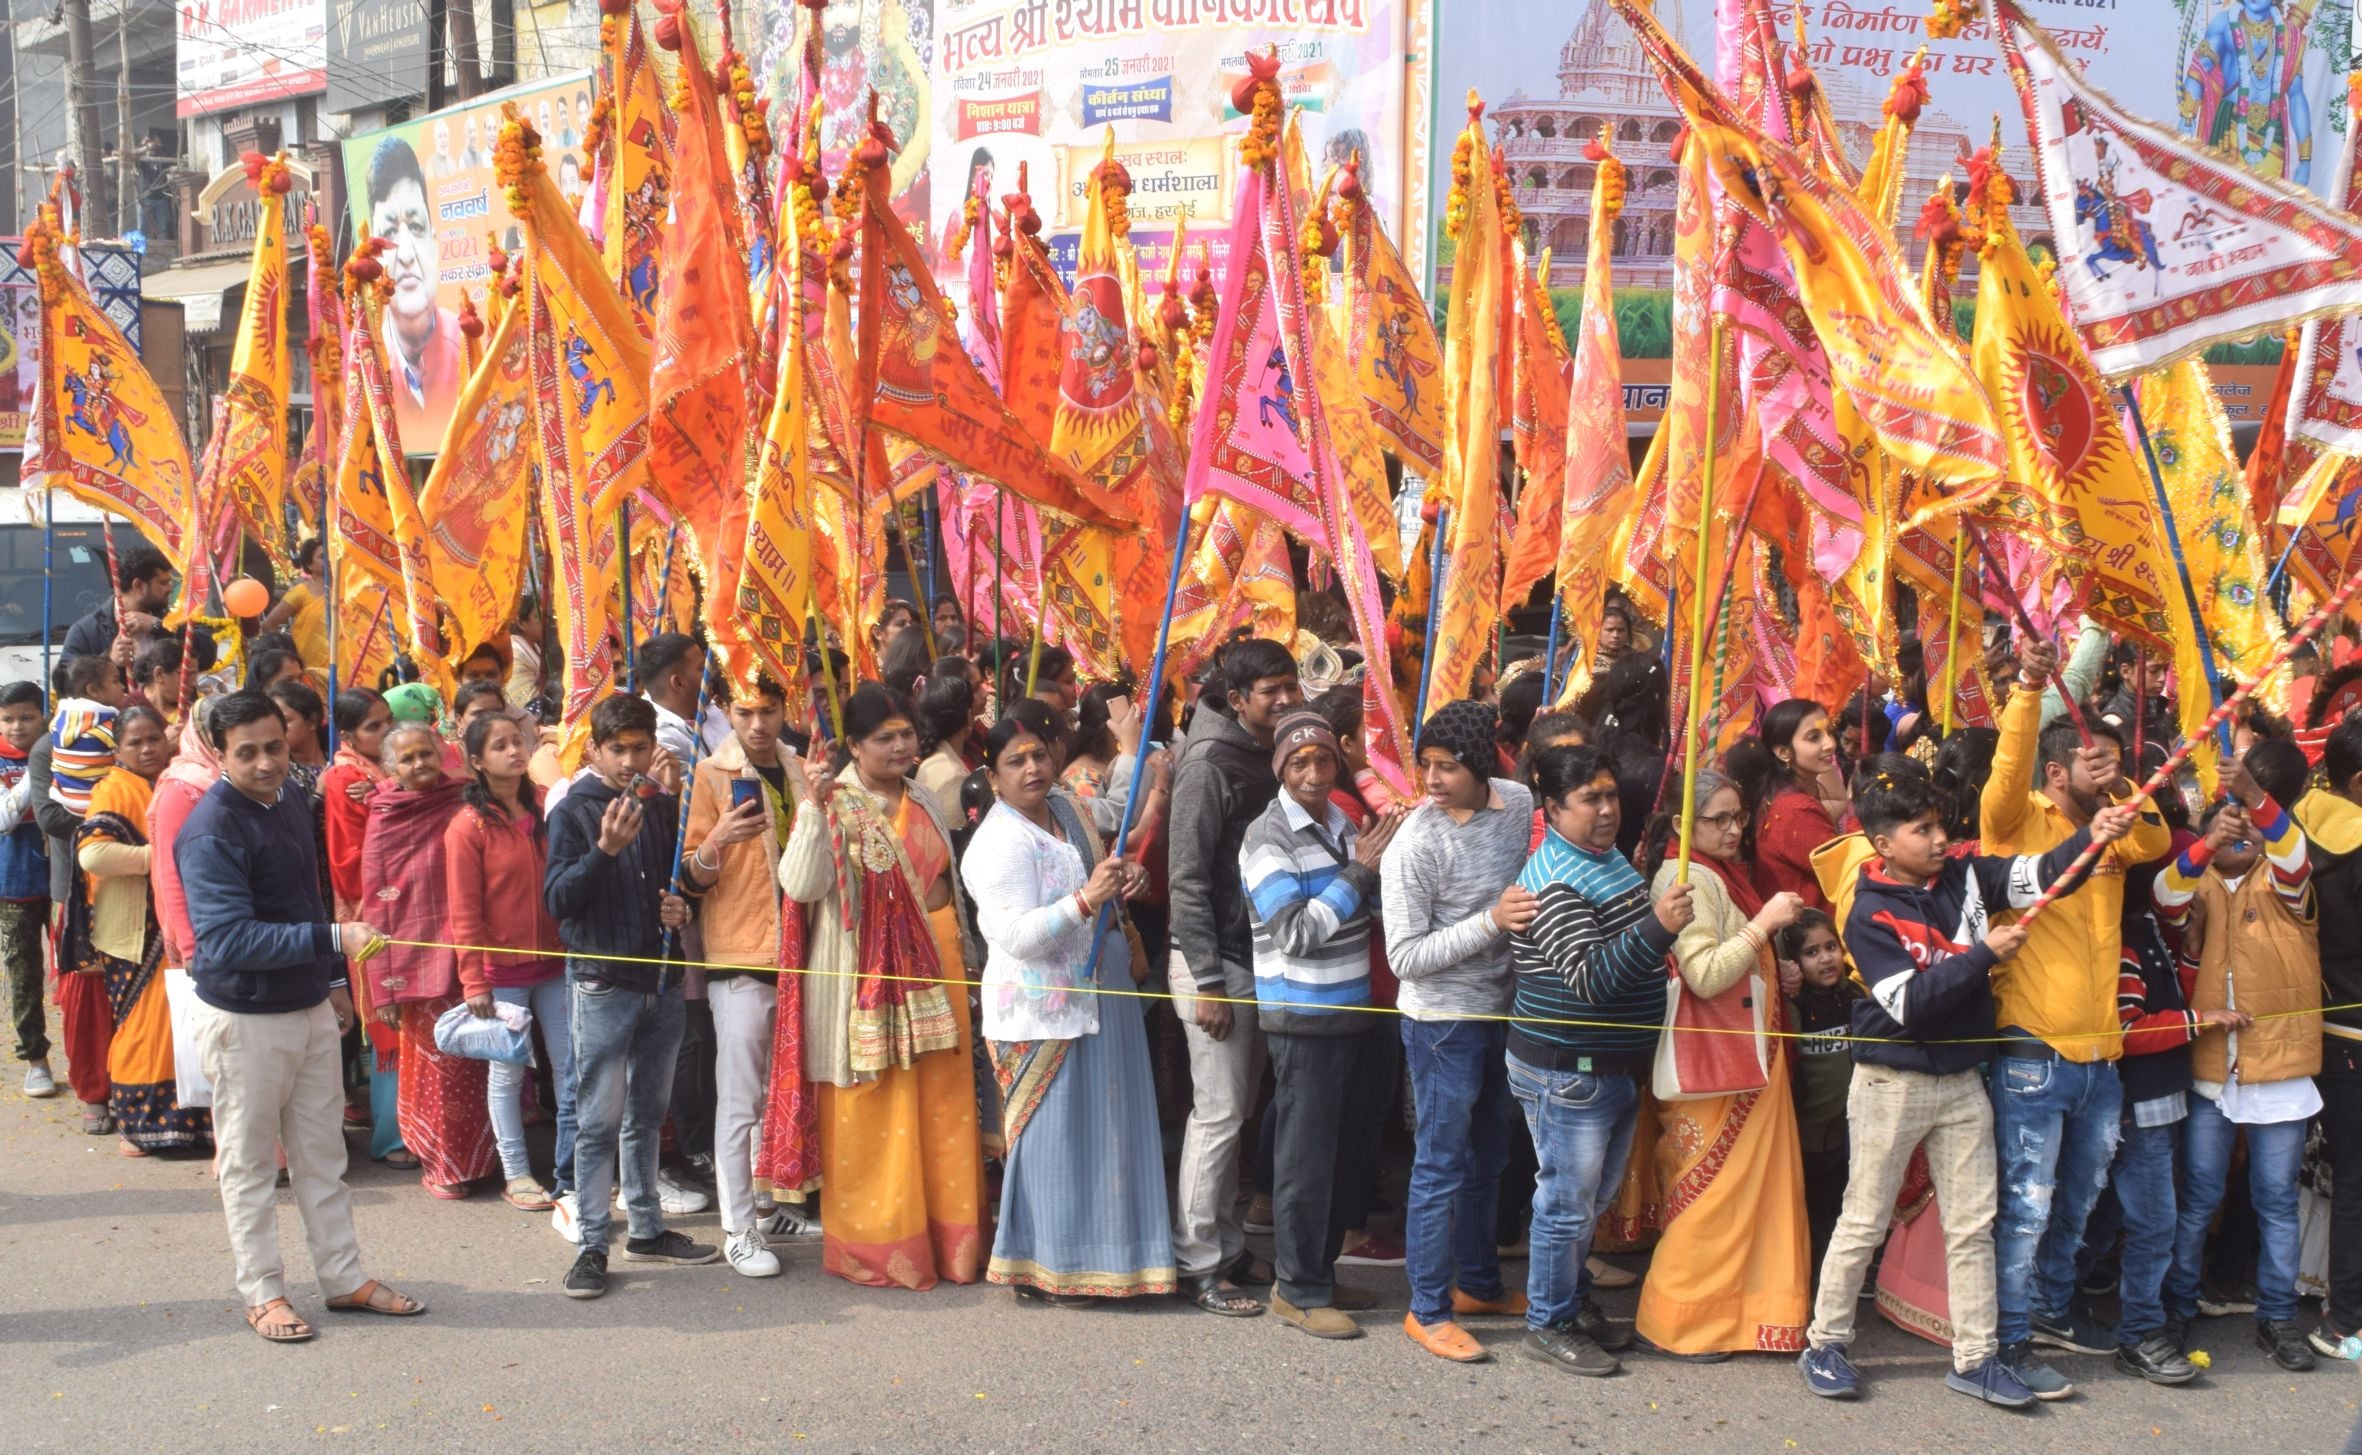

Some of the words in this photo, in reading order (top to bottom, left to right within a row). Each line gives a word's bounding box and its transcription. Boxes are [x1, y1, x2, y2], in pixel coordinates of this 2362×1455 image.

[1821, 0, 1922, 34] निर्माण
[1105, 57, 1119, 77] 25
[1121, 52, 1150, 74] जनवरी
[1152, 55, 1175, 72] 2021
[1840, 46, 1895, 77] प्रभु
[1952, 54, 1996, 76] घर
[978, 71, 991, 90] 24
[993, 66, 1021, 88] जनवरी
[1022, 69, 1044, 86] 2021
[966, 102, 1005, 119] निशान
[1142, 170, 1219, 193] धर्मशाला
[441, 237, 479, 261] 2021
